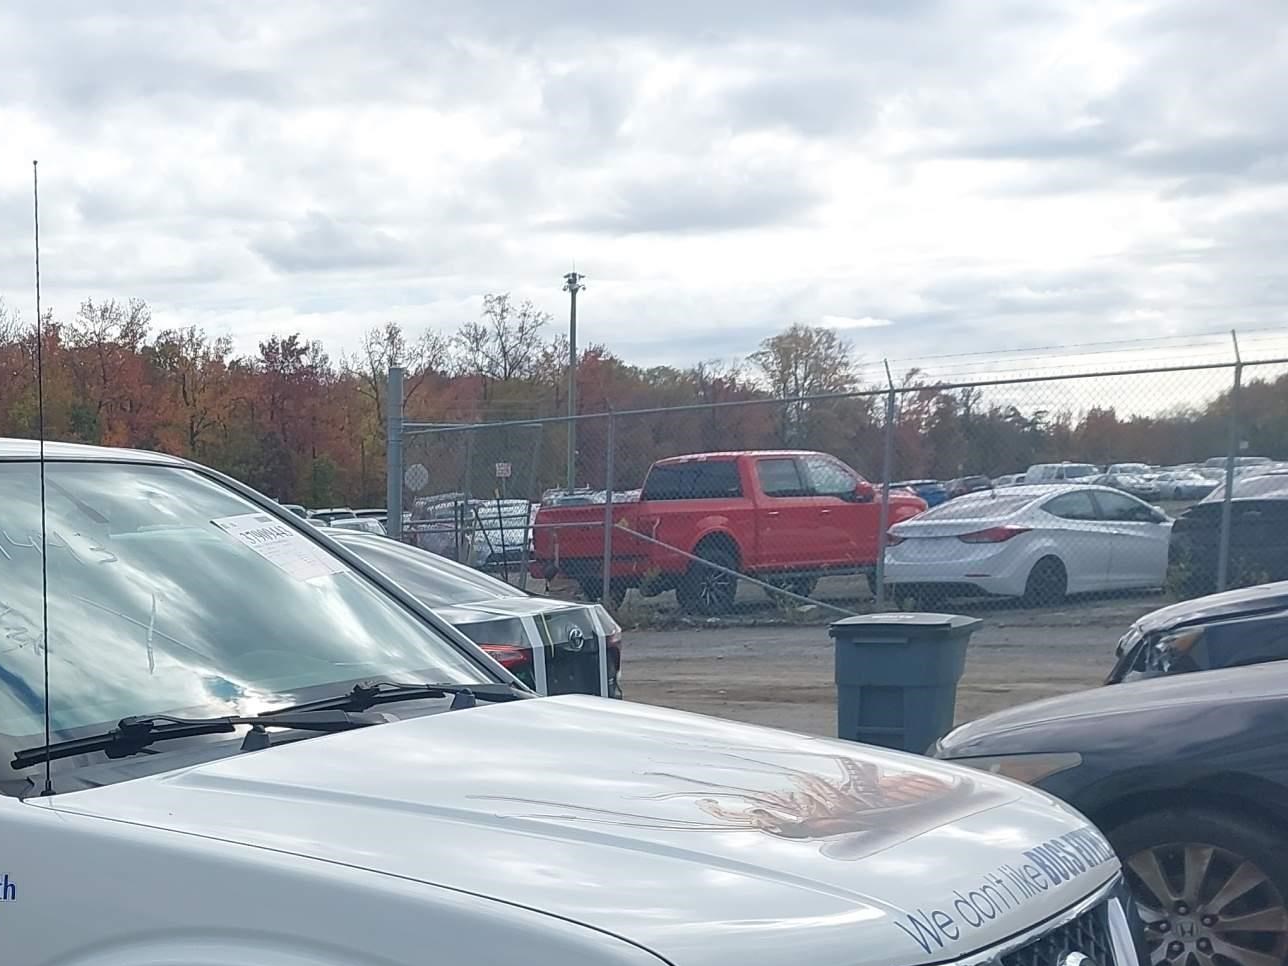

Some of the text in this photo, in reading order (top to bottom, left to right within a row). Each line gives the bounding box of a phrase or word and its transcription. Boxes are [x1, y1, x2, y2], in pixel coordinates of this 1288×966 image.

[893, 908, 960, 954] We
[953, 872, 1011, 927] don't
[997, 863, 1049, 905] like
